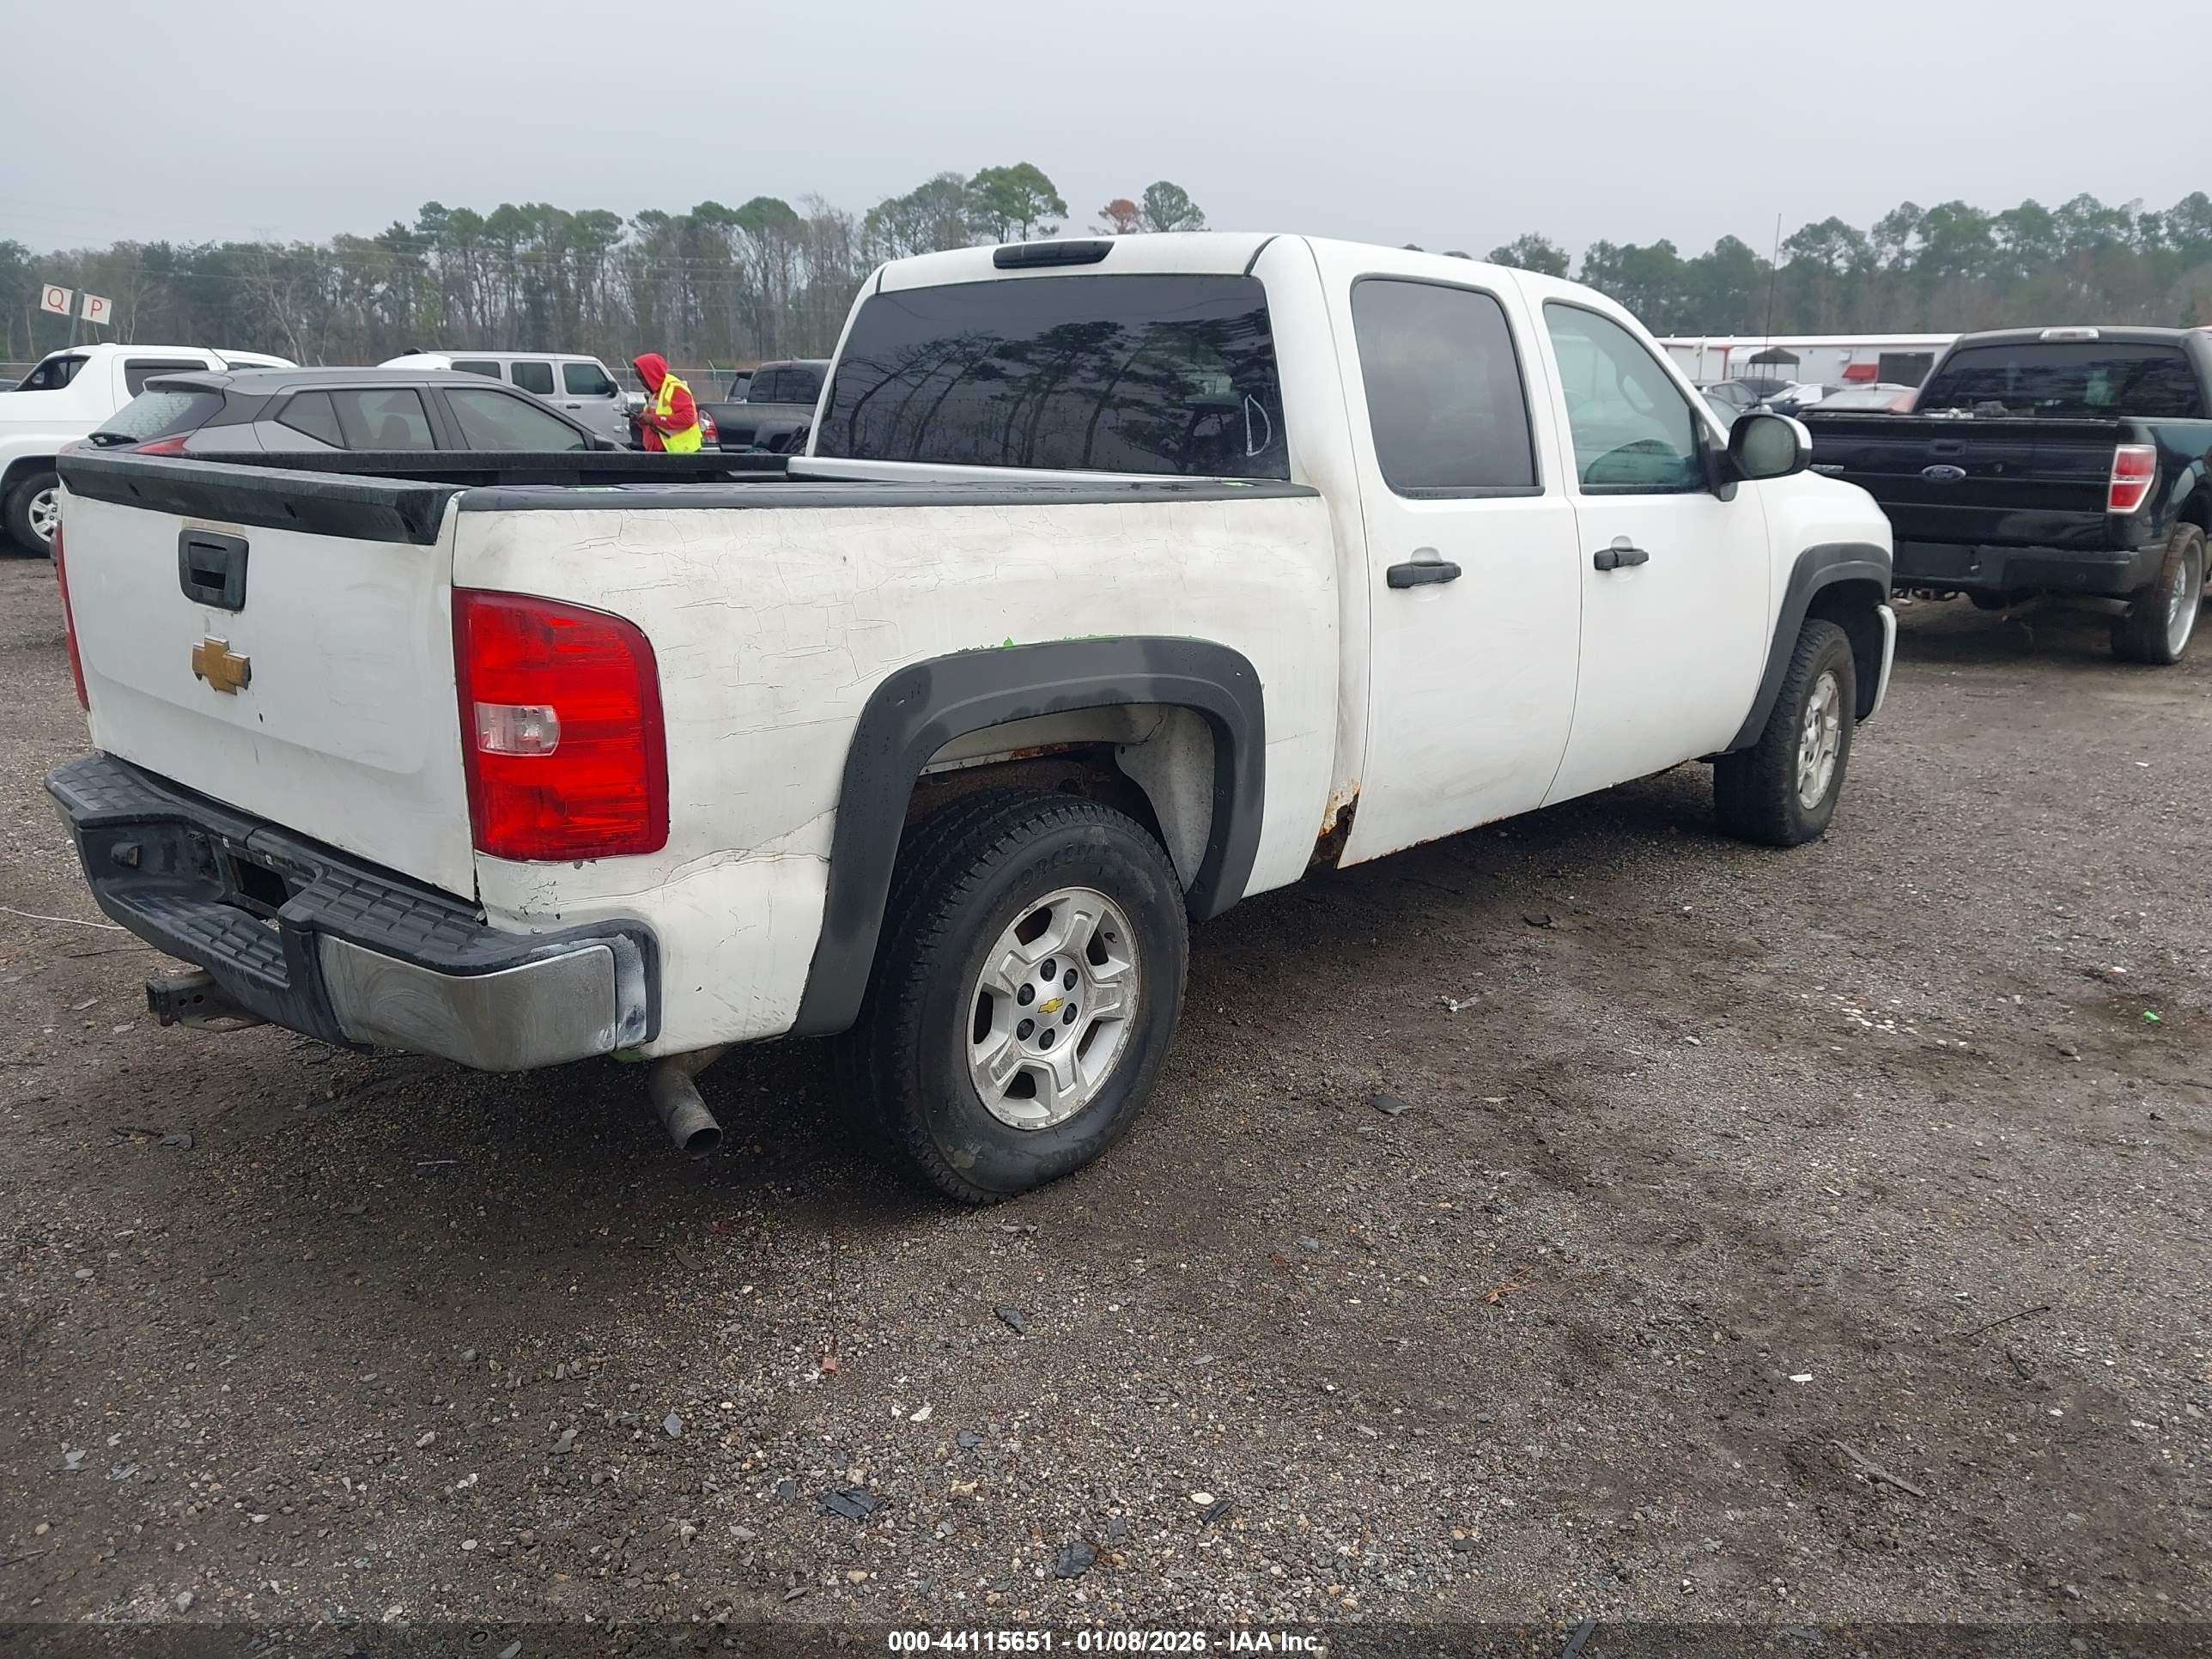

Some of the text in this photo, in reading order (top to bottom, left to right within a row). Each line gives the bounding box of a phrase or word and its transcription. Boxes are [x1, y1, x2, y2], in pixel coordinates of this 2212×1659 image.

[48, 289, 64, 312] Q
[90, 299, 103, 317] P
[1244, 393, 1272, 456] D
